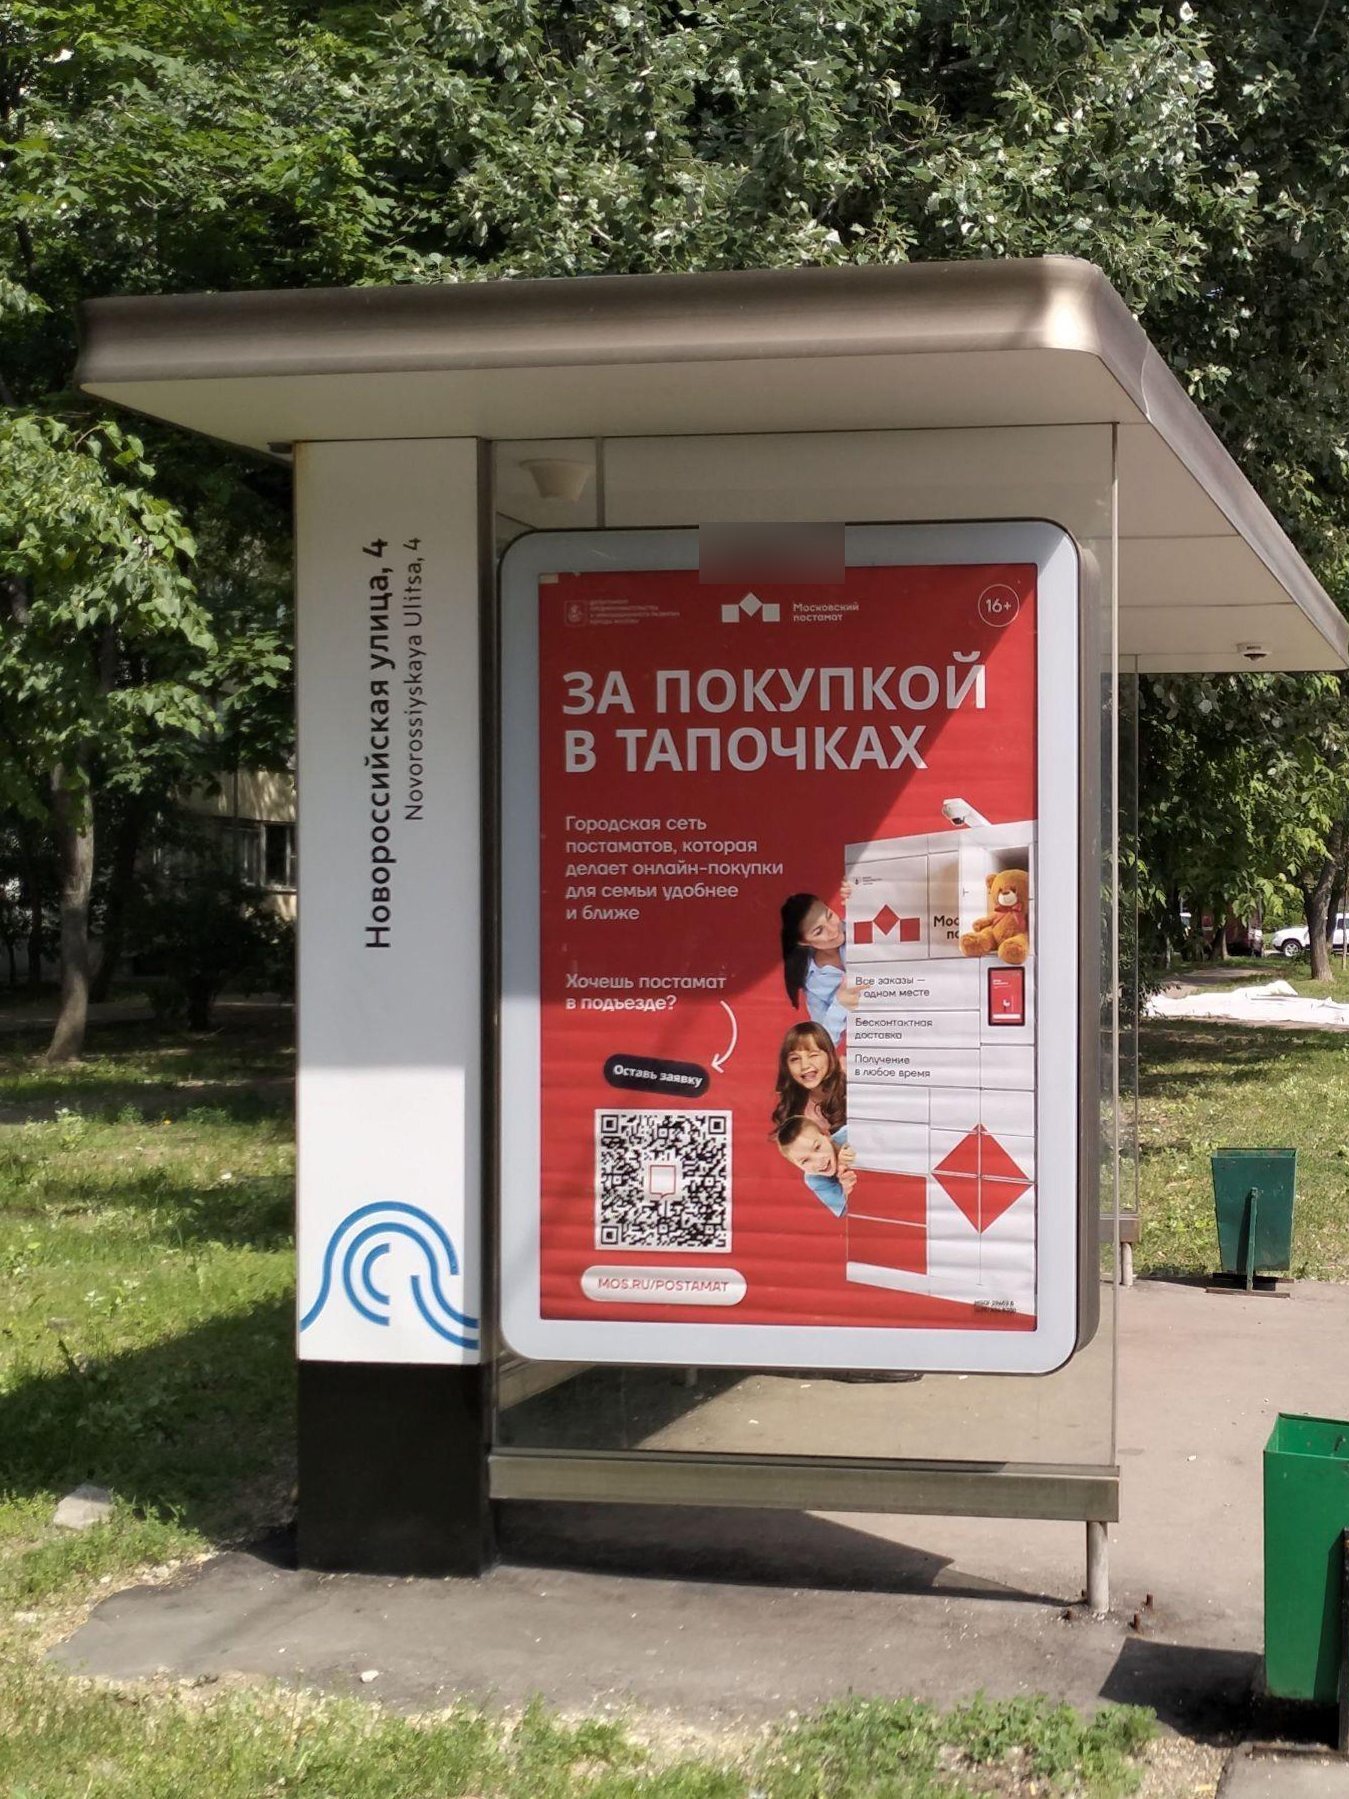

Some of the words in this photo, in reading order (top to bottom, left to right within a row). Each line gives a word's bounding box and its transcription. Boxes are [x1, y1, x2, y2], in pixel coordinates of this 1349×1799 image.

[362, 537, 389, 558] 4
[403, 537, 422, 551] 4
[403, 556, 425, 627] Ulitsa,
[793, 601, 860, 613] Московский
[986, 598, 1012, 613] 16+
[368, 566, 395, 672] улица,
[793, 614, 843, 623] постамат
[562, 671, 635, 715] ЗА
[657, 650, 987, 713] ПОКУПКОЙ
[403, 634, 427, 821] Novorossiyskaya
[565, 730, 597, 773] В
[616, 725, 928, 772] ТАПОЧКАХ
[362, 679, 396, 949] Новороссийская
[565, 816, 661, 834] Городская
[666, 817, 707, 831] сеть
[566, 840, 677, 855] постаматов,
[682, 839, 758, 855] которая
[565, 864, 628, 877] делает
[632, 860, 784, 878] онлайн-покупки
[565, 886, 596, 899] для
[601, 886, 657, 897] семьи
[662, 883, 739, 900] удобнее
[566, 909, 577, 920] и
[582, 905, 640, 920] ближе
[565, 974, 634, 990] Хочешь
[639, 975, 726, 989] постамат
[855, 976, 875, 986] Все
[878, 977, 914, 985] заказы
[864, 990, 896, 998] одном
[899, 989, 930, 997] месте
[565, 999, 576, 1010] в
[581, 995, 677, 1012] подъезде?
[855, 1017, 933, 1027] Бесконтактная
[855, 1032, 902, 1040] доставка
[855, 1053, 910, 1065] Получение
[613, 1064, 658, 1080] Оставь
[659, 1072, 703, 1089] заявку
[863, 1067, 895, 1077] любое
[898, 1070, 931, 1079] время
[598, 1277, 730, 1293] MOS.RU/POSTAMAT
